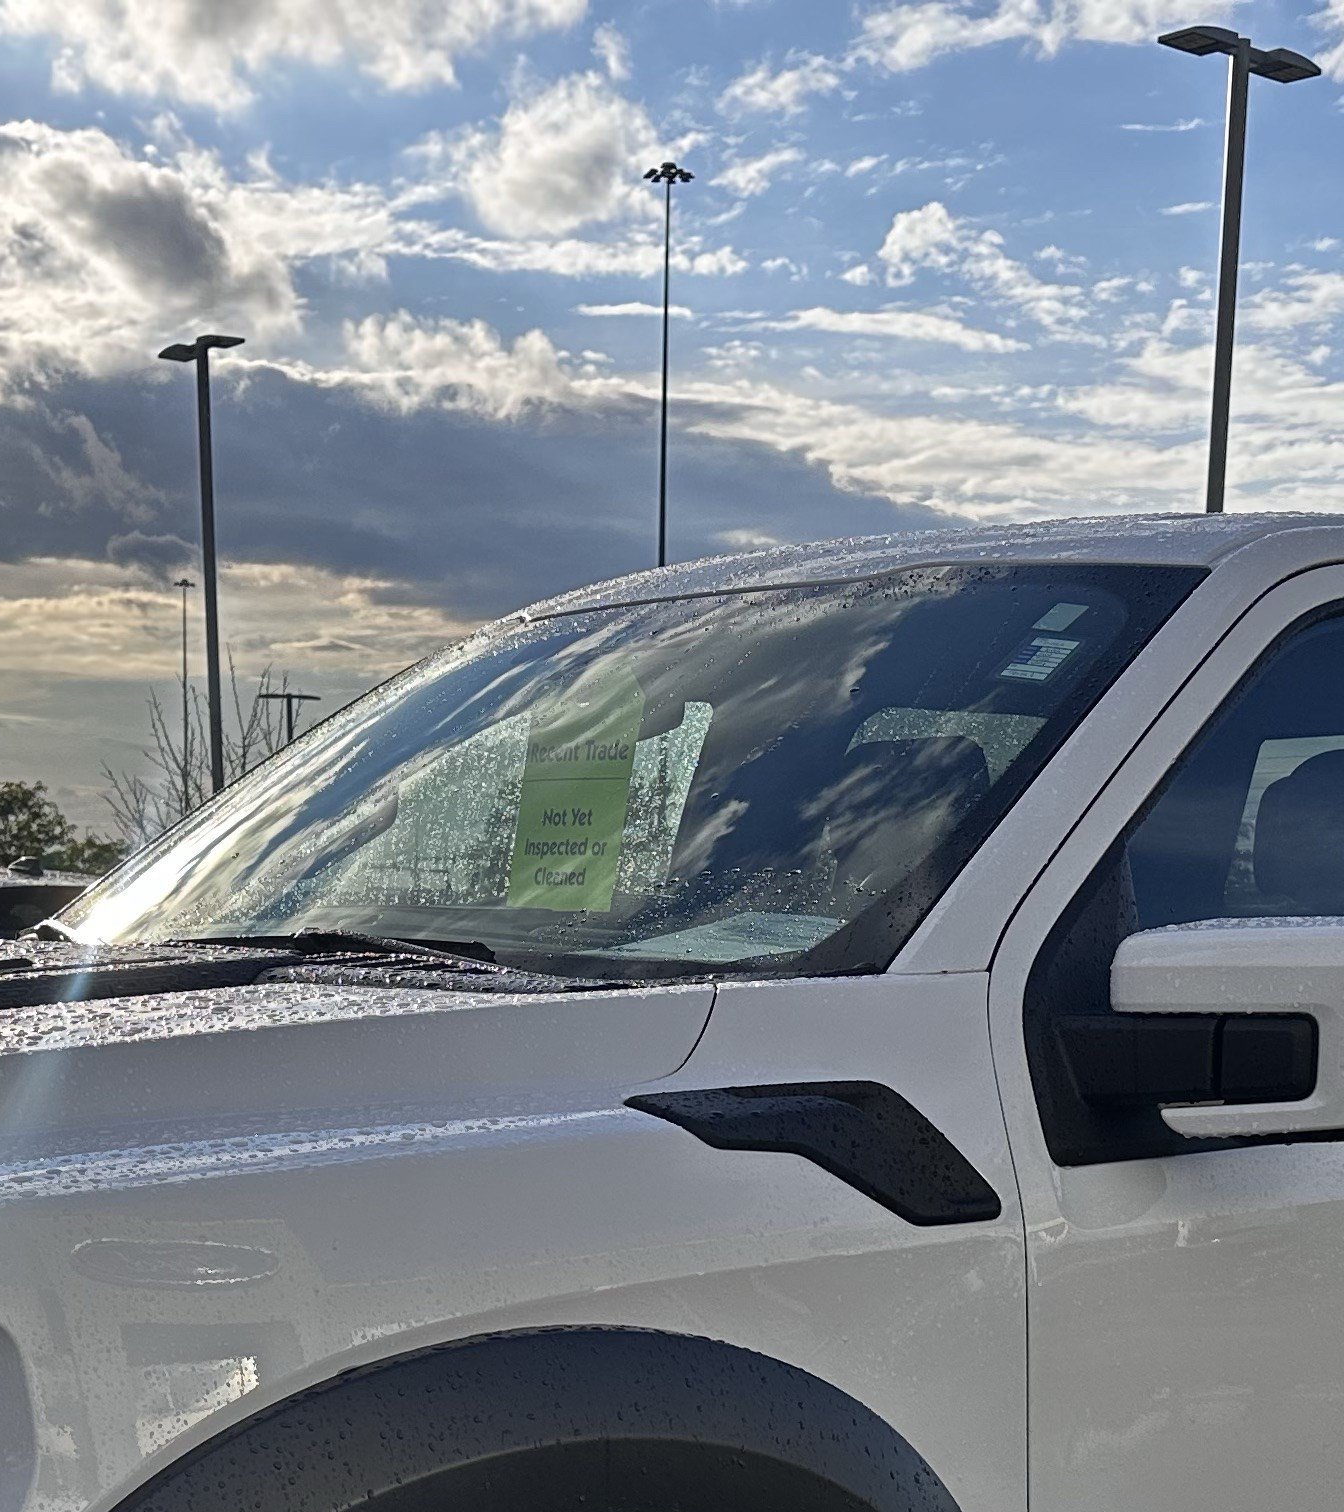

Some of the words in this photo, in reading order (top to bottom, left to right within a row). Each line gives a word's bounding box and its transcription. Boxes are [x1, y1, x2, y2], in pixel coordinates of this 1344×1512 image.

[529, 743, 579, 763] Recent
[586, 740, 629, 761] Trade
[542, 808, 567, 826] Not
[571, 808, 593, 826] Yet
[524, 837, 588, 859] Inspected
[592, 842, 608, 856] or
[534, 868, 586, 886] Cleaned
